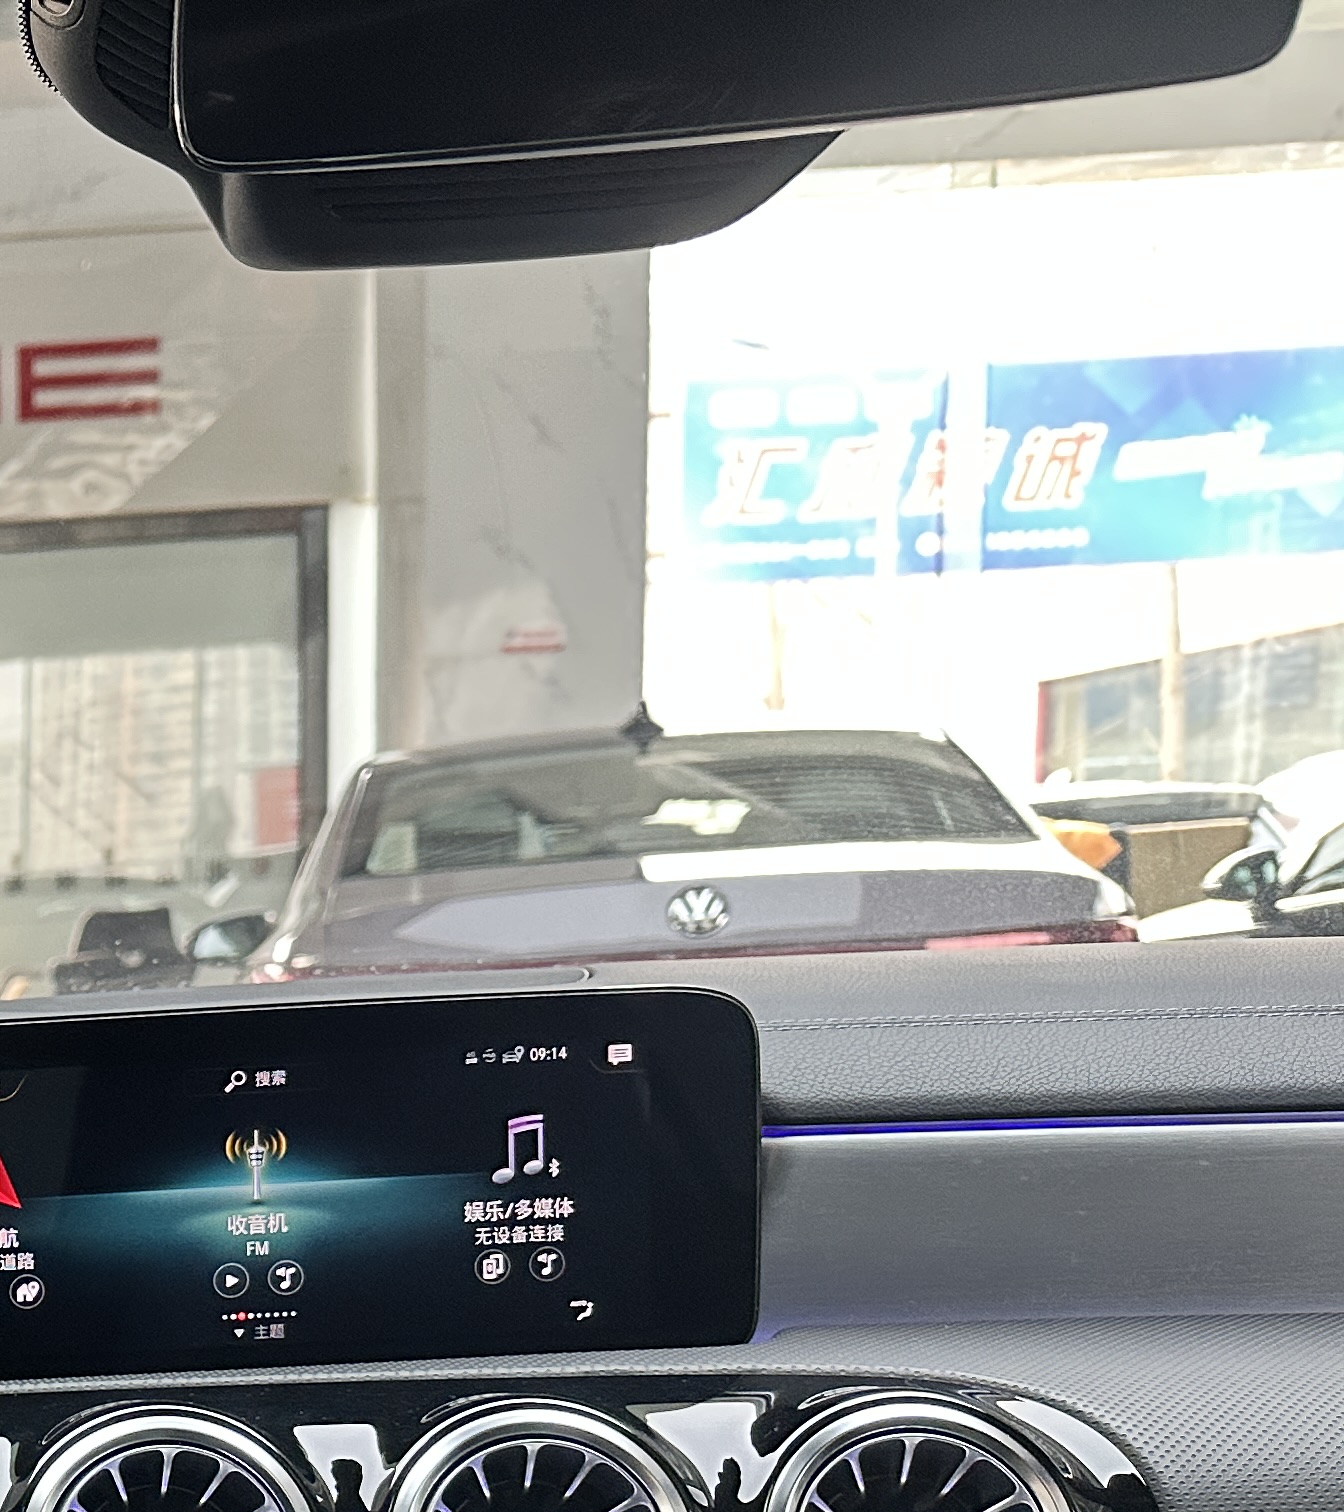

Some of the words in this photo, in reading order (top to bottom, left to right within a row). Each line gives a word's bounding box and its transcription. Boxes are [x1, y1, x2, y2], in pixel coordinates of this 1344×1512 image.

[530, 1046, 568, 1061] 09:14
[255, 1070, 287, 1087] 搜索
[464, 1197, 575, 1222] 娱乐/多媒体
[227, 1212, 288, 1236] 收音机
[475, 1224, 565, 1245] 无设备连接
[246, 1241, 270, 1256] FM
[254, 1323, 285, 1340] 主题
